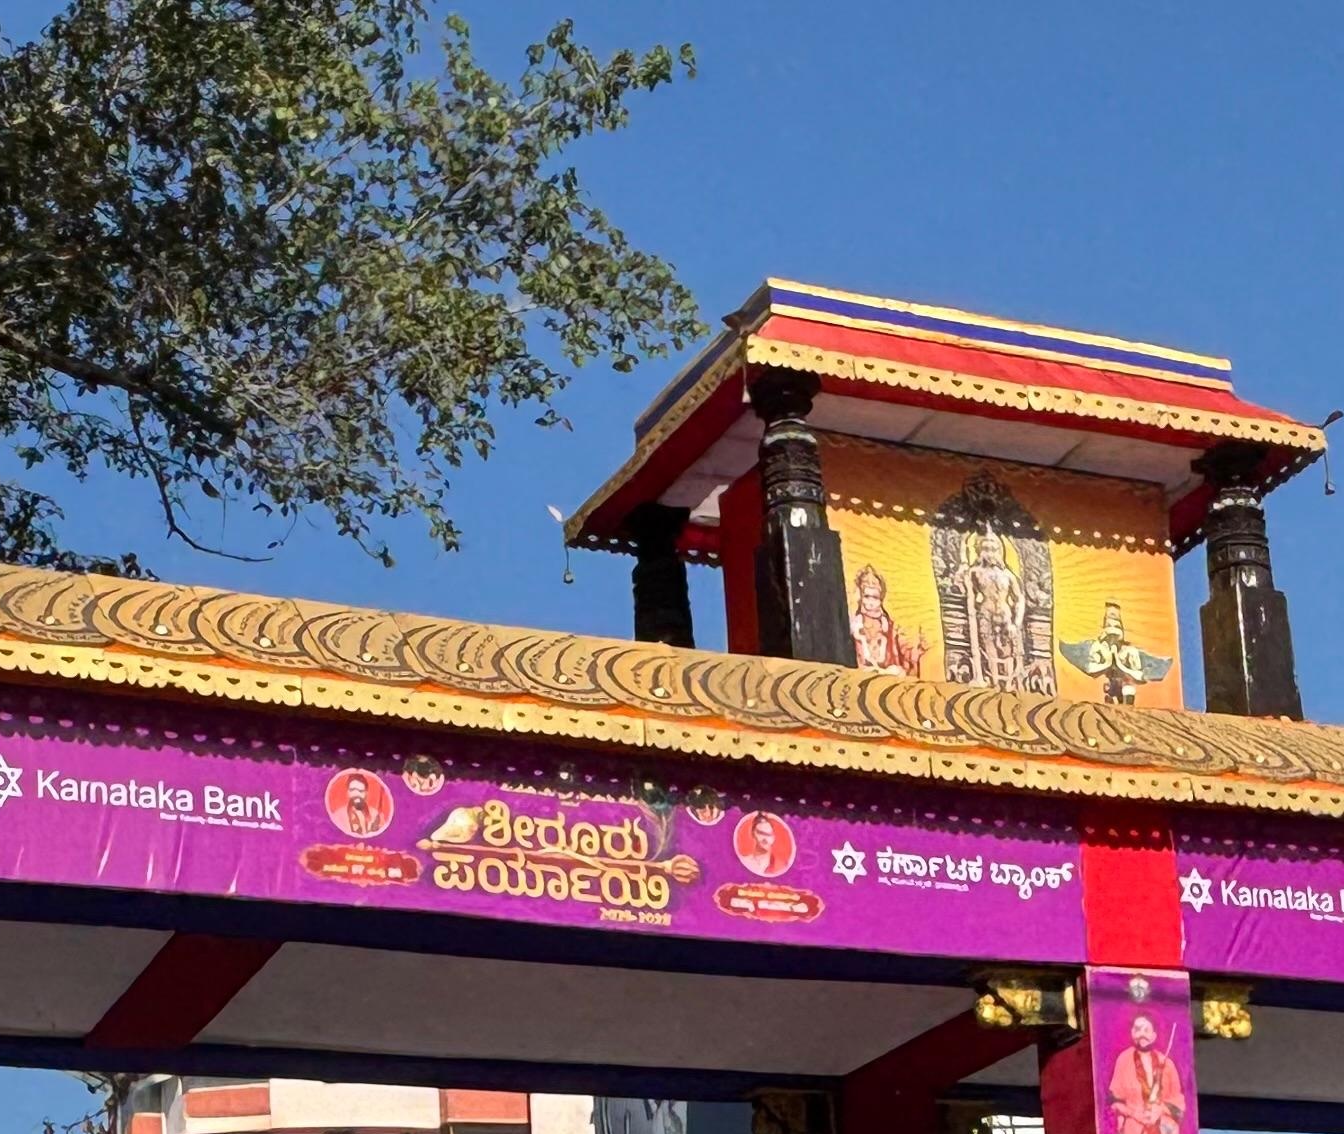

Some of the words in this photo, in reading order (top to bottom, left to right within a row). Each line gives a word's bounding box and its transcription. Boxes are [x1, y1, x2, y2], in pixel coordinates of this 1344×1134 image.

[37, 769, 194, 813] Karnataka
[209, 786, 282, 822] Bank
[1220, 880, 1334, 914] Karnataka
